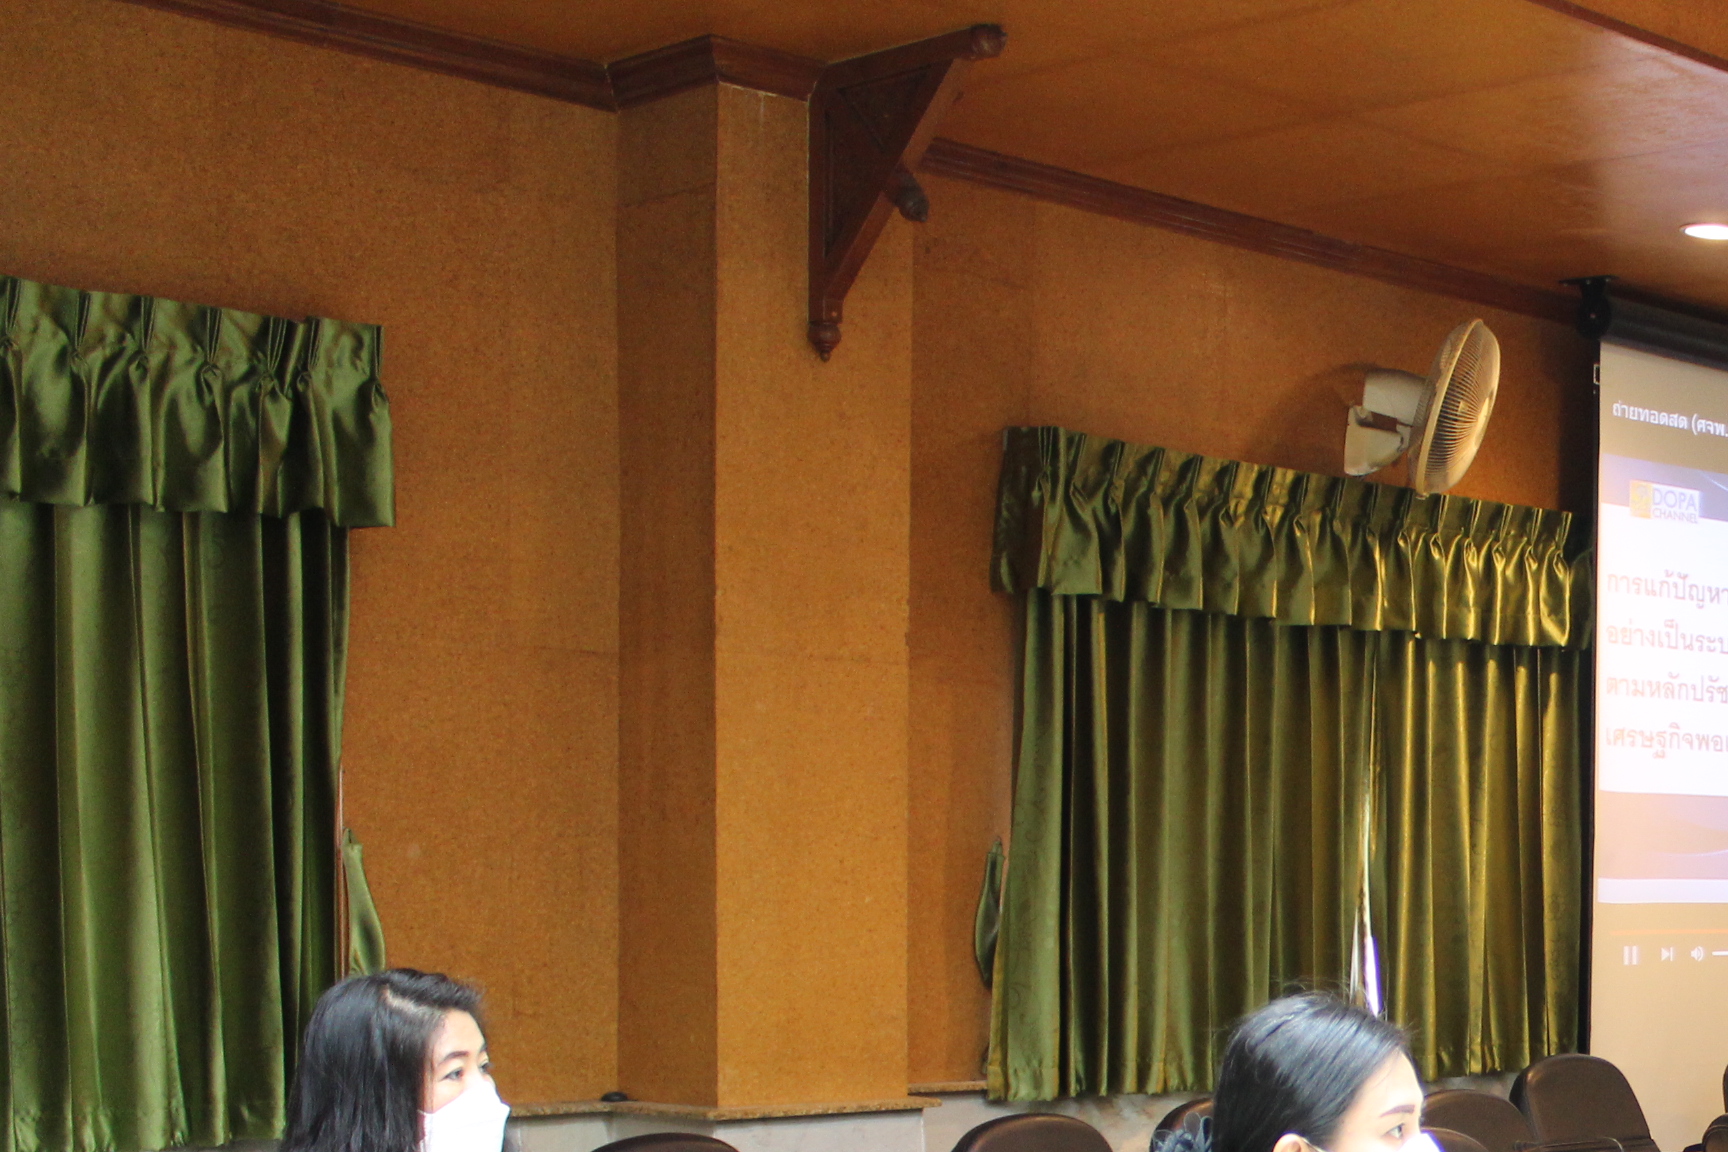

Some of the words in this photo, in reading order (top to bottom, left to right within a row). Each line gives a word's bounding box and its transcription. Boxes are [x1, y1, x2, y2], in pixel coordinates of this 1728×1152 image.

[1612, 400, 1688, 430] ถ่ายทอดสด
[1653, 487, 1697, 512] DOPA
[1652, 507, 1698, 524] CHANNEL
